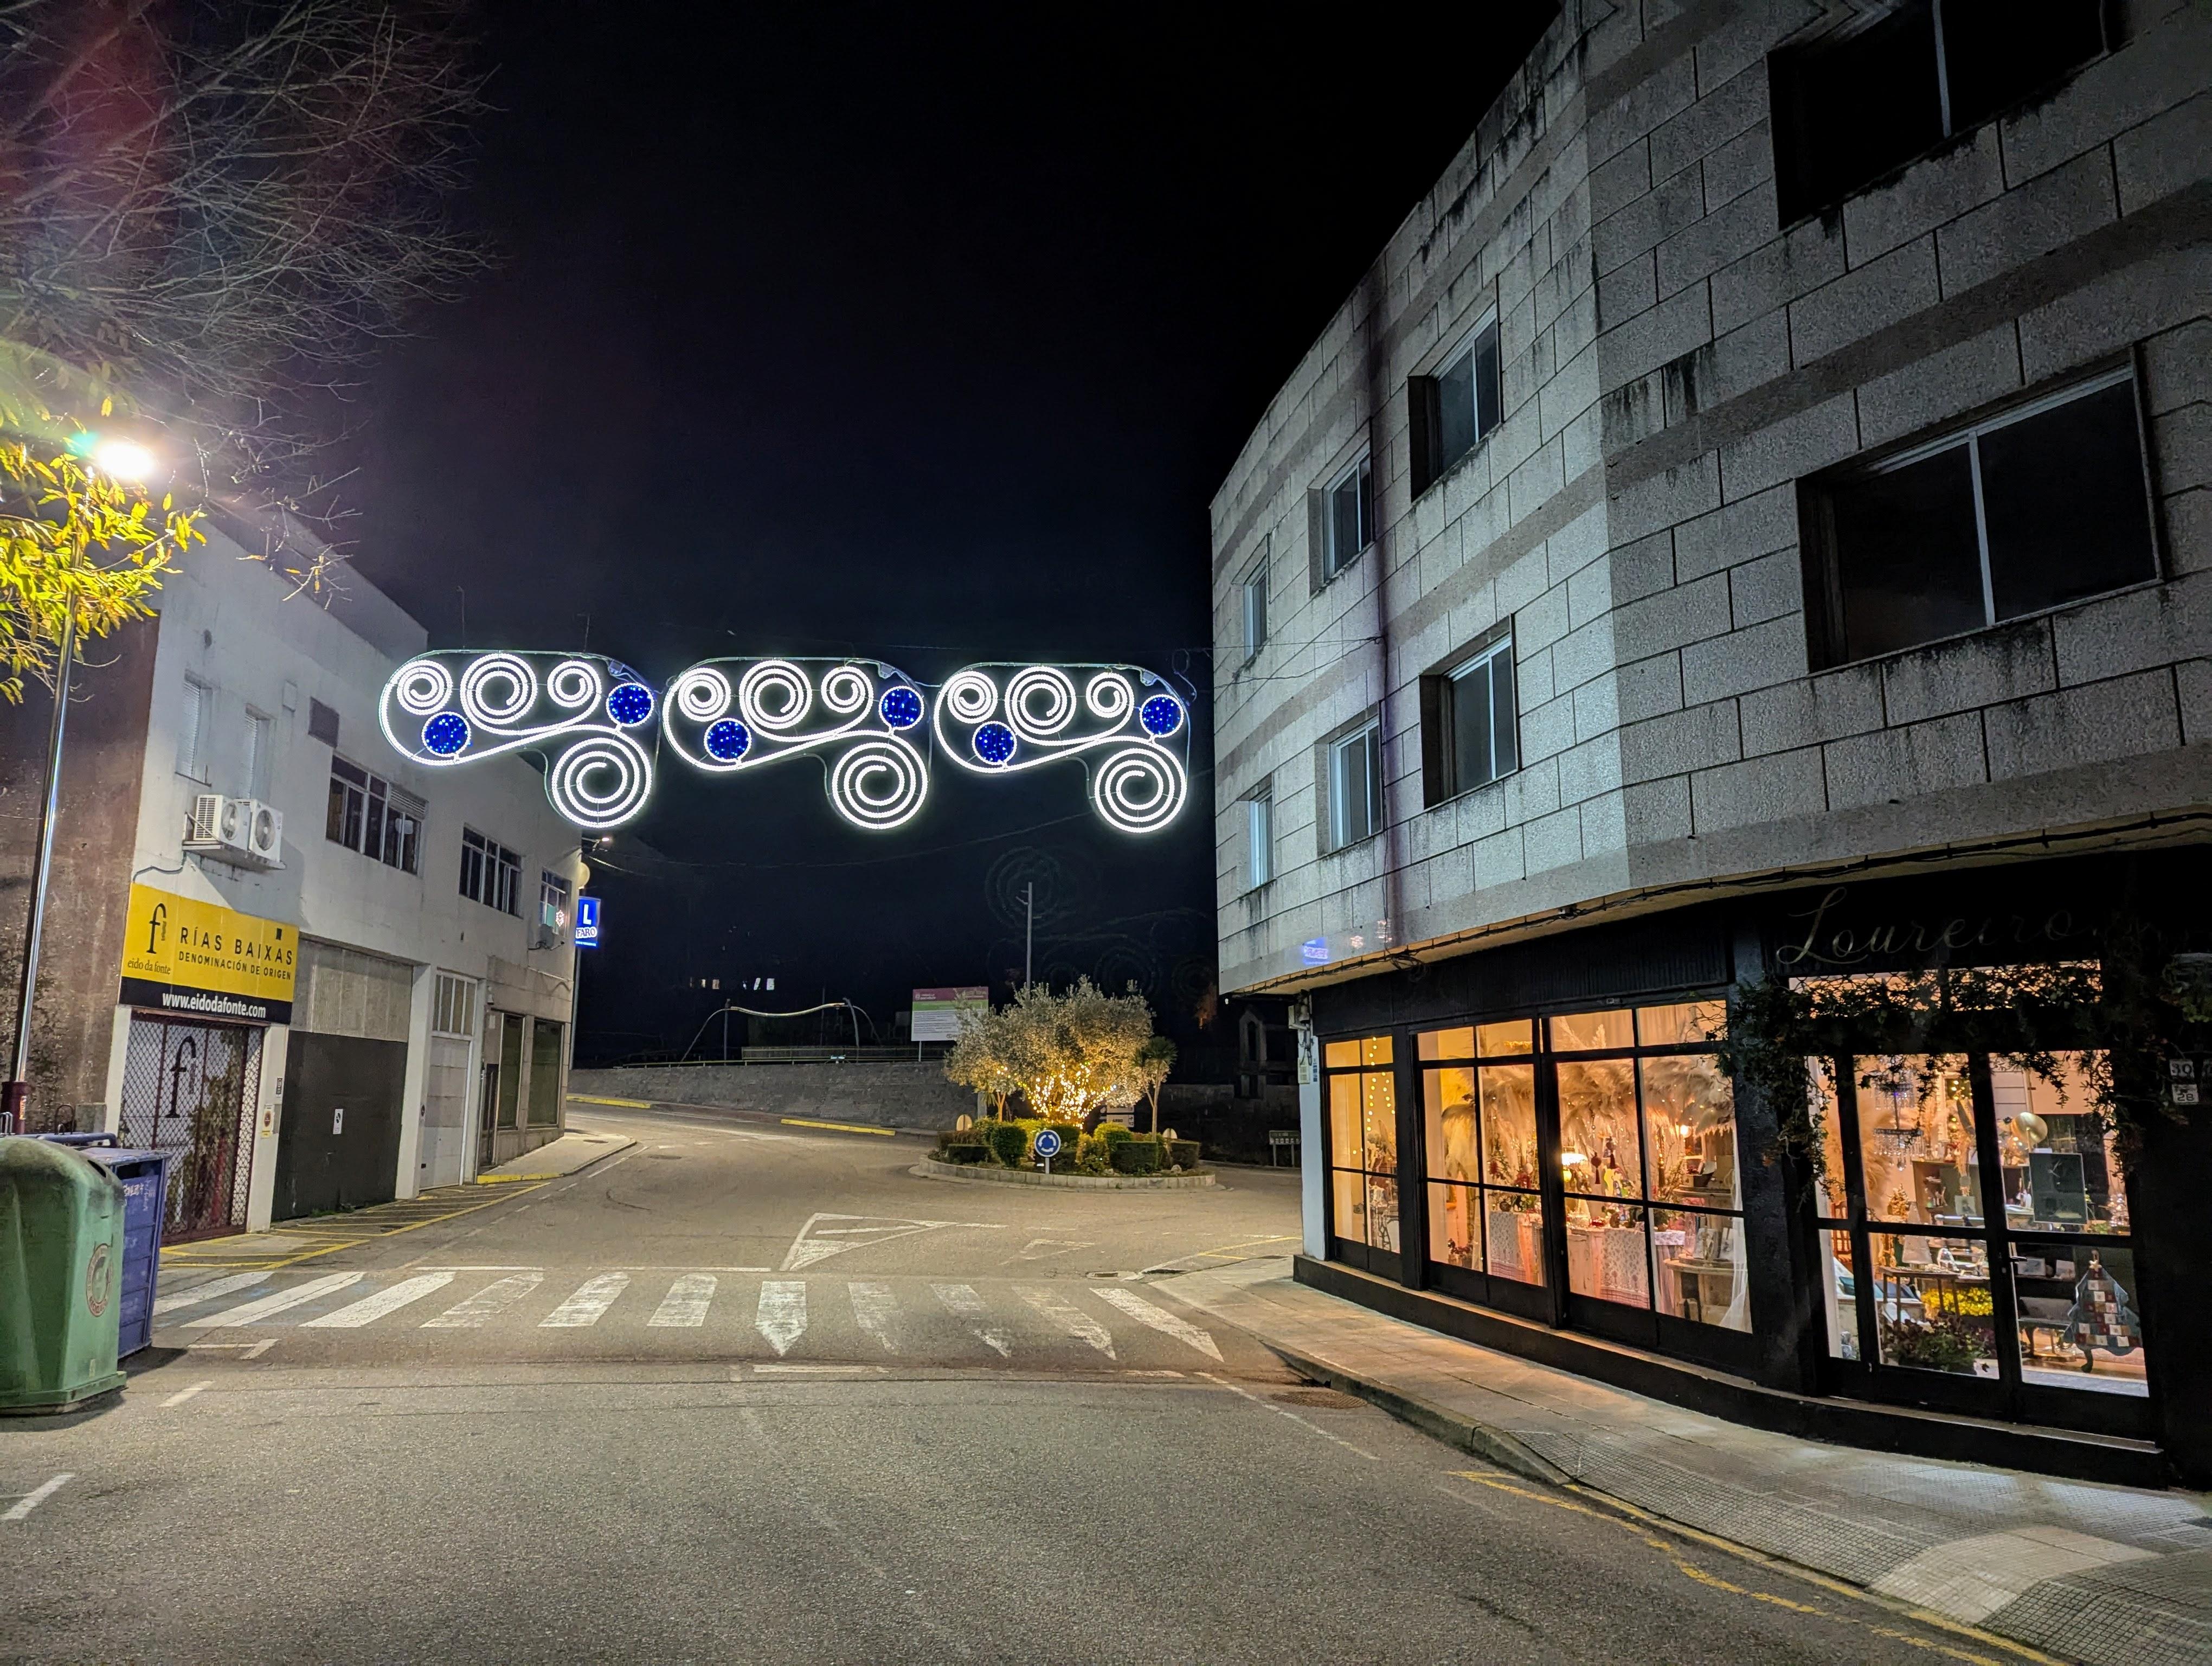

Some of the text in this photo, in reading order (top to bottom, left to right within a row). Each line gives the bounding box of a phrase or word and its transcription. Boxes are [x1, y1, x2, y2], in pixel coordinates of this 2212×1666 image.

[583, 905, 591, 925] L
[577, 928, 595, 937] FARO
[180, 926, 292, 965] RÍAS BAIXAS
[127, 958, 171, 975] eido da fonte
[179, 951, 291, 980] DENOMINACIÓN DE ORIGEN
[162, 992, 267, 1018] www.eidodafonte.com
